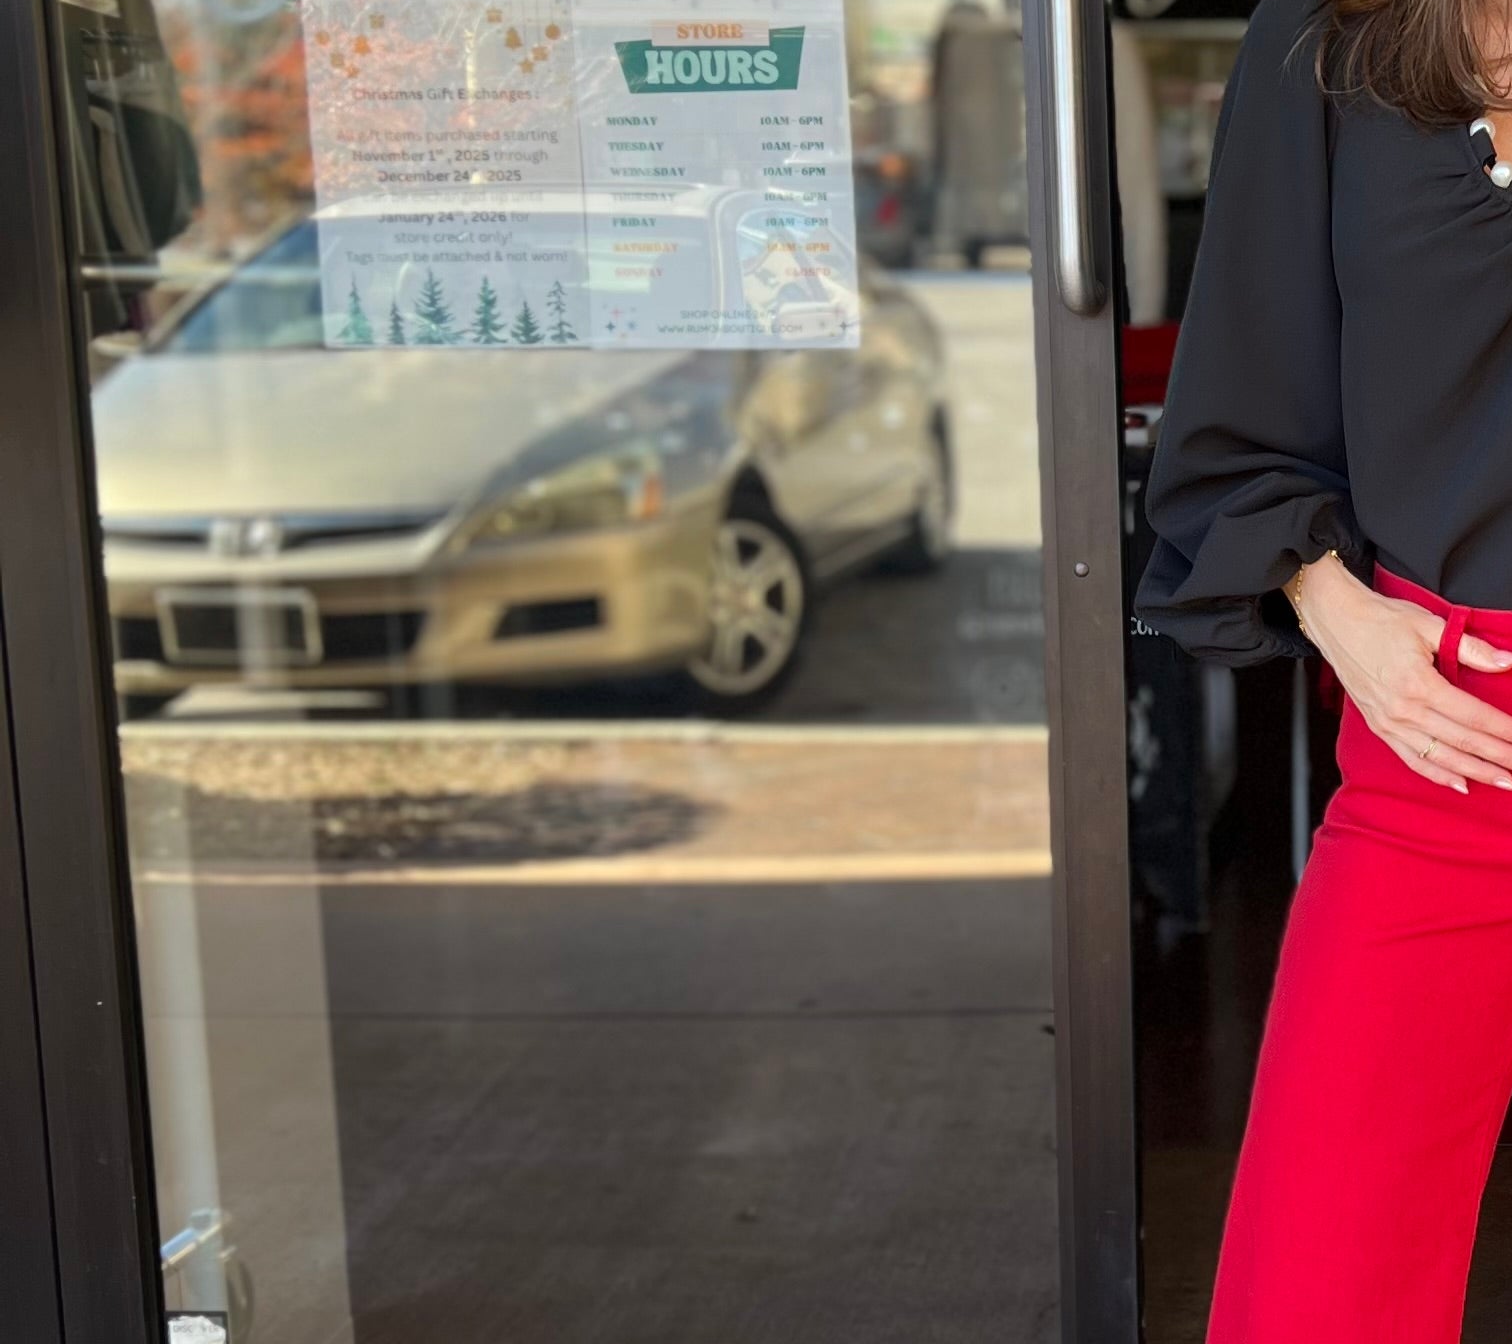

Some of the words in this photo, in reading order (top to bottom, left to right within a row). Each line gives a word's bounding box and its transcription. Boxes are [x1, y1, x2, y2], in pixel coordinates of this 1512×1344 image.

[677, 23, 744, 40] STORE
[644, 49, 780, 86] HOURS
[352, 88, 423, 101] Christmas
[426, 88, 453, 101] Gift
[606, 116, 659, 127] MONDAY
[383, 130, 423, 142] items
[425, 130, 500, 144] purchased
[502, 130, 559, 144] starting
[608, 141, 665, 152] TUESDAY
[352, 150, 424, 163] November
[454, 150, 490, 163] 2025
[493, 149, 549, 165] through
[377, 170, 450, 183] December
[487, 170, 523, 183] 2025
[609, 166, 686, 178] WEDNESDAY
[377, 212, 433, 226] January
[471, 212, 507, 224] 2026
[612, 217, 657, 228] FRIDAY
[393, 233, 429, 244] store
[479, 231, 514, 246] only!
[345, 251, 375, 266] Tags
[413, 251, 429, 263] be
[431, 251, 492, 263] attached
[506, 252, 529, 263] not
[680, 309, 708, 321] SHOP
